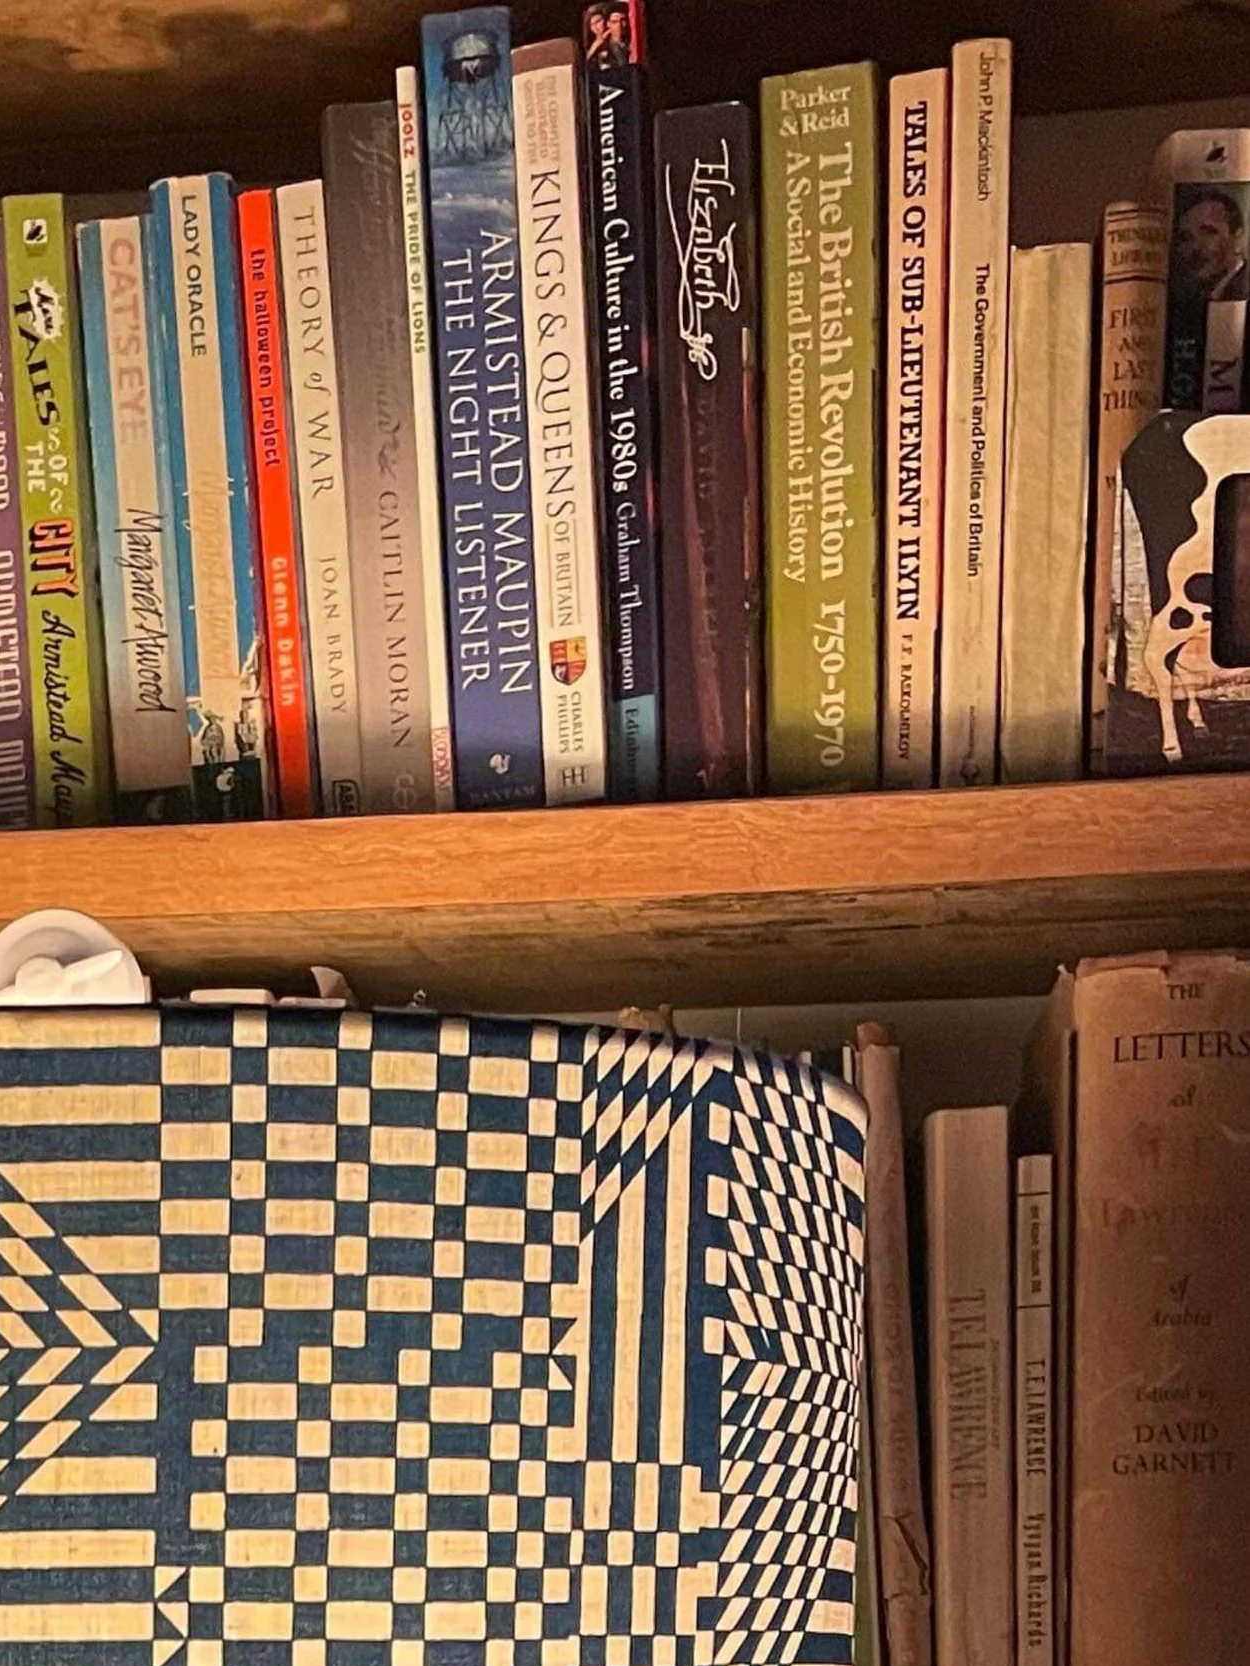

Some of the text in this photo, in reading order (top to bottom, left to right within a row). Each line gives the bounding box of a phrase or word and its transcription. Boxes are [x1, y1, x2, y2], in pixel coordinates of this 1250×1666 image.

[780, 85, 851, 110] Parker
[801, 106, 850, 134] Reid
[976, 111, 992, 201] Mackintosh
[107, 238, 141, 359] CAT'S
[181, 195, 207, 357] LADY ORACLE
[404, 170, 426, 354] THE PRIDE OF LIONS
[597, 83, 643, 494] American Culture in the 1980s
[250, 249, 279, 468] the halloween project
[292, 208, 336, 499] THEORY WAR
[528, 170, 575, 628] KINGS & QUEENS BRITAIN
[783, 180, 813, 583] Social and Economic History
[897, 101, 929, 621] TALES OF SUB-LIEUTENANT ILYIN
[966, 262, 989, 577] The Government and Politics Britain
[25, 442, 78, 598] OF THE CITY
[441, 249, 489, 690] THE NIGHT LISTENER
[479, 229, 532, 694] ARMISTEAD MAUPIN
[812, 142, 854, 767] The British Revolution 1750-1970
[114, 508, 165, 620] Margaret
[272, 558, 294, 632] Glenn
[377, 491, 413, 749] CAITLIN MORAN
[616, 502, 643, 691] Graham Thompson
[40, 610, 84, 744] Armistead
[326, 634, 348, 714] BRADY
[557, 695, 570, 753] PHILLIPS
[571, 691, 583, 752] CHARLES
[1112, 1030, 1250, 1063] LETTERS
[1134, 1423, 1219, 1446] DAVID
[1024, 1575, 1047, 1649] Richards
